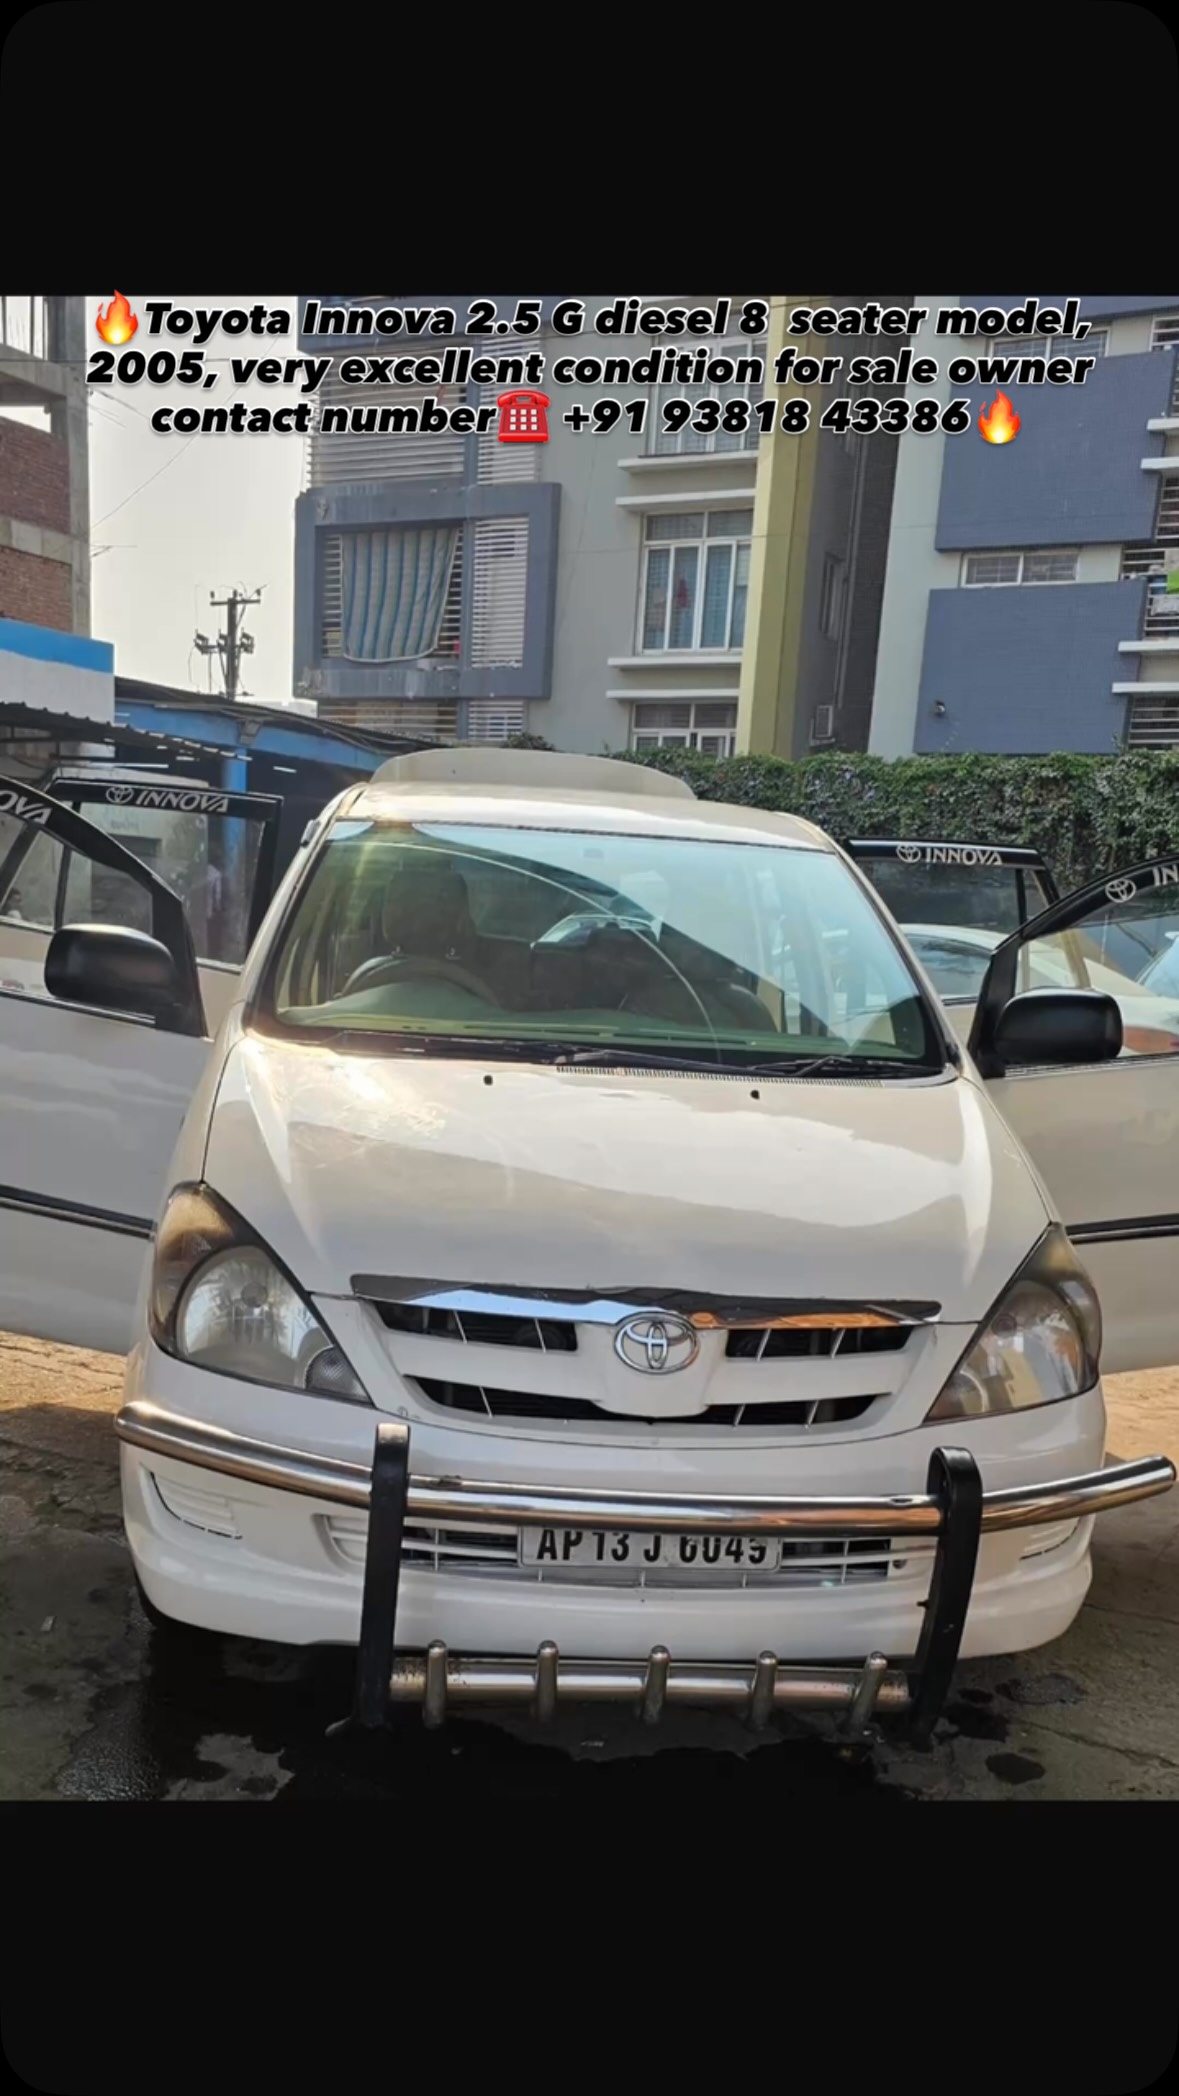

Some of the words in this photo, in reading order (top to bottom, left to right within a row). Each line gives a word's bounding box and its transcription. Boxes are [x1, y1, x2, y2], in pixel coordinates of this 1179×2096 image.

[136, 790, 228, 812] INNOVA
[925, 847, 1002, 865] INNOVA
[537, 1529, 583, 1560] AP
[592, 1532, 629, 1561] 13
[643, 1534, 662, 1562] J
